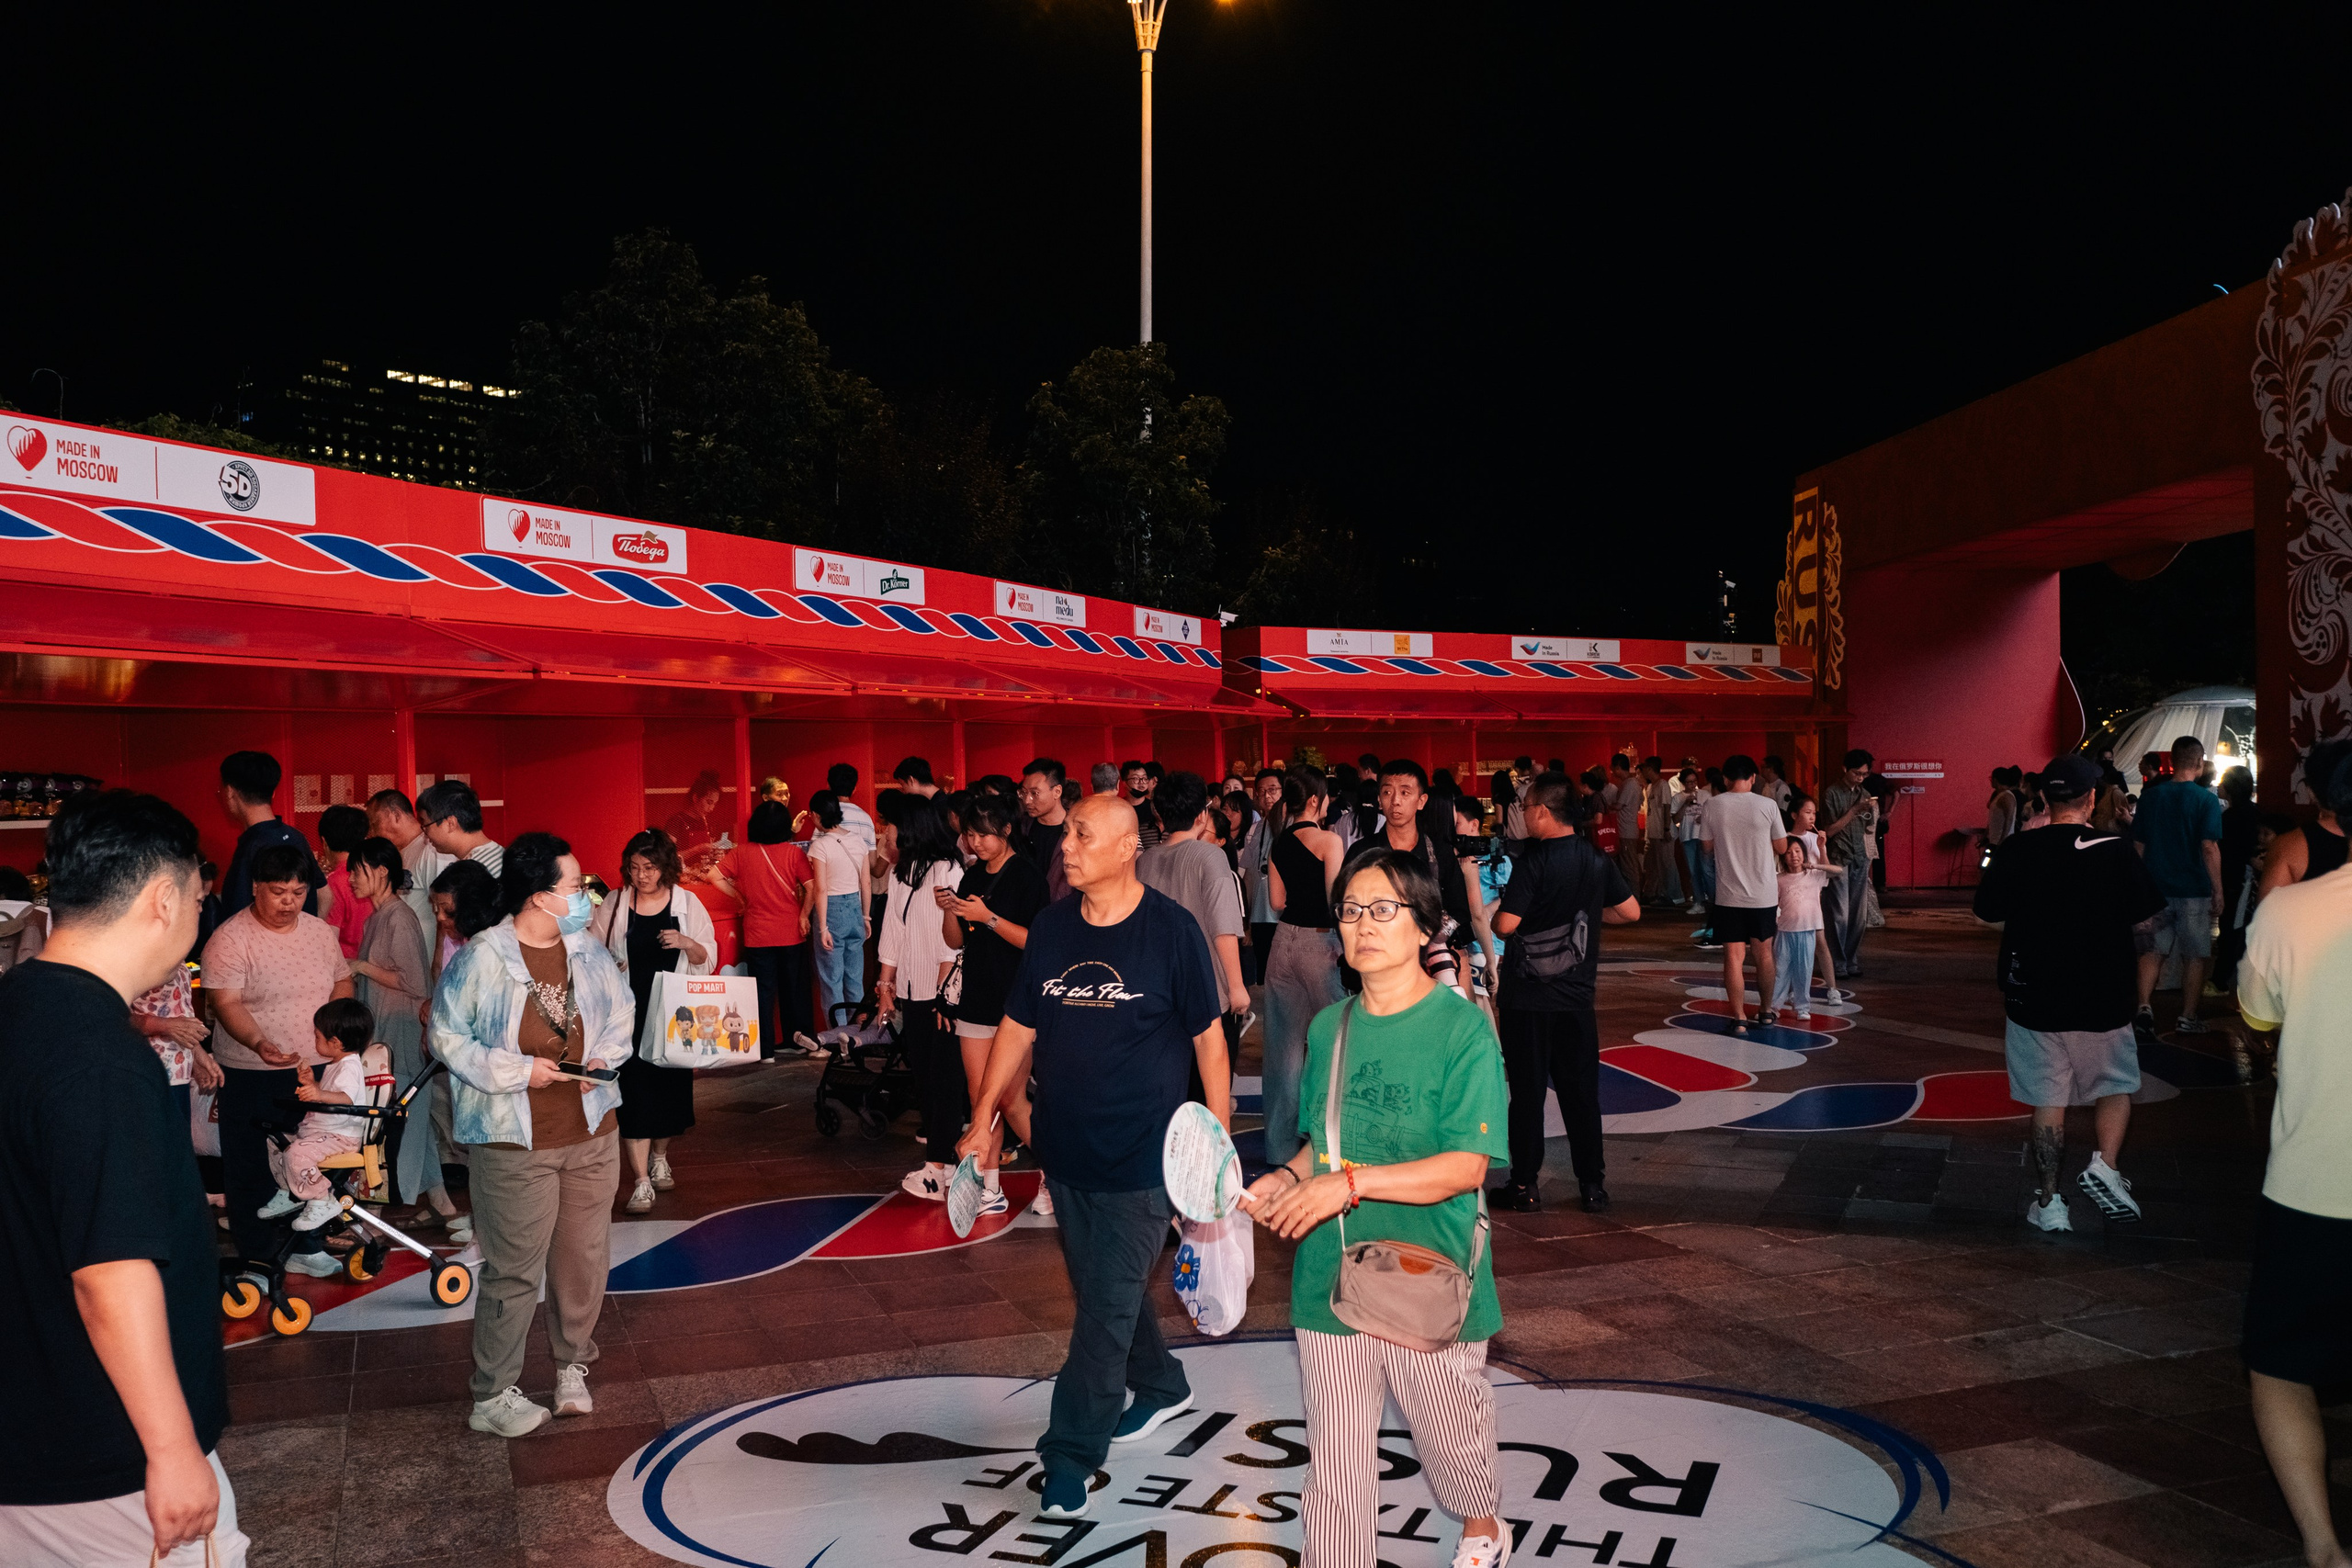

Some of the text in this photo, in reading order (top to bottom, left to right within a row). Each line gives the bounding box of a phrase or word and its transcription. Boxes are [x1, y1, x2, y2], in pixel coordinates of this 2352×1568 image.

[56, 439, 100, 459] MADE IN
[57, 457, 119, 483] MOSCOW
[535, 517, 560, 531] MADE IN
[536, 532, 571, 548] MOSCOW
[617, 536, 665, 561] Победа
[827, 562, 843, 572] MADE IN
[827, 573, 850, 587] MOSCOW
[1018, 602, 1034, 613] MOSCOW
[1056, 604, 1073, 616] medu
[1884, 762, 1942, 771] 我在俄罗斯很想你
[688, 983, 724, 992] POP MART
[1042, 979, 1144, 1000] Fit the Flow
[1118, 1474, 1441, 1544] TSTE
